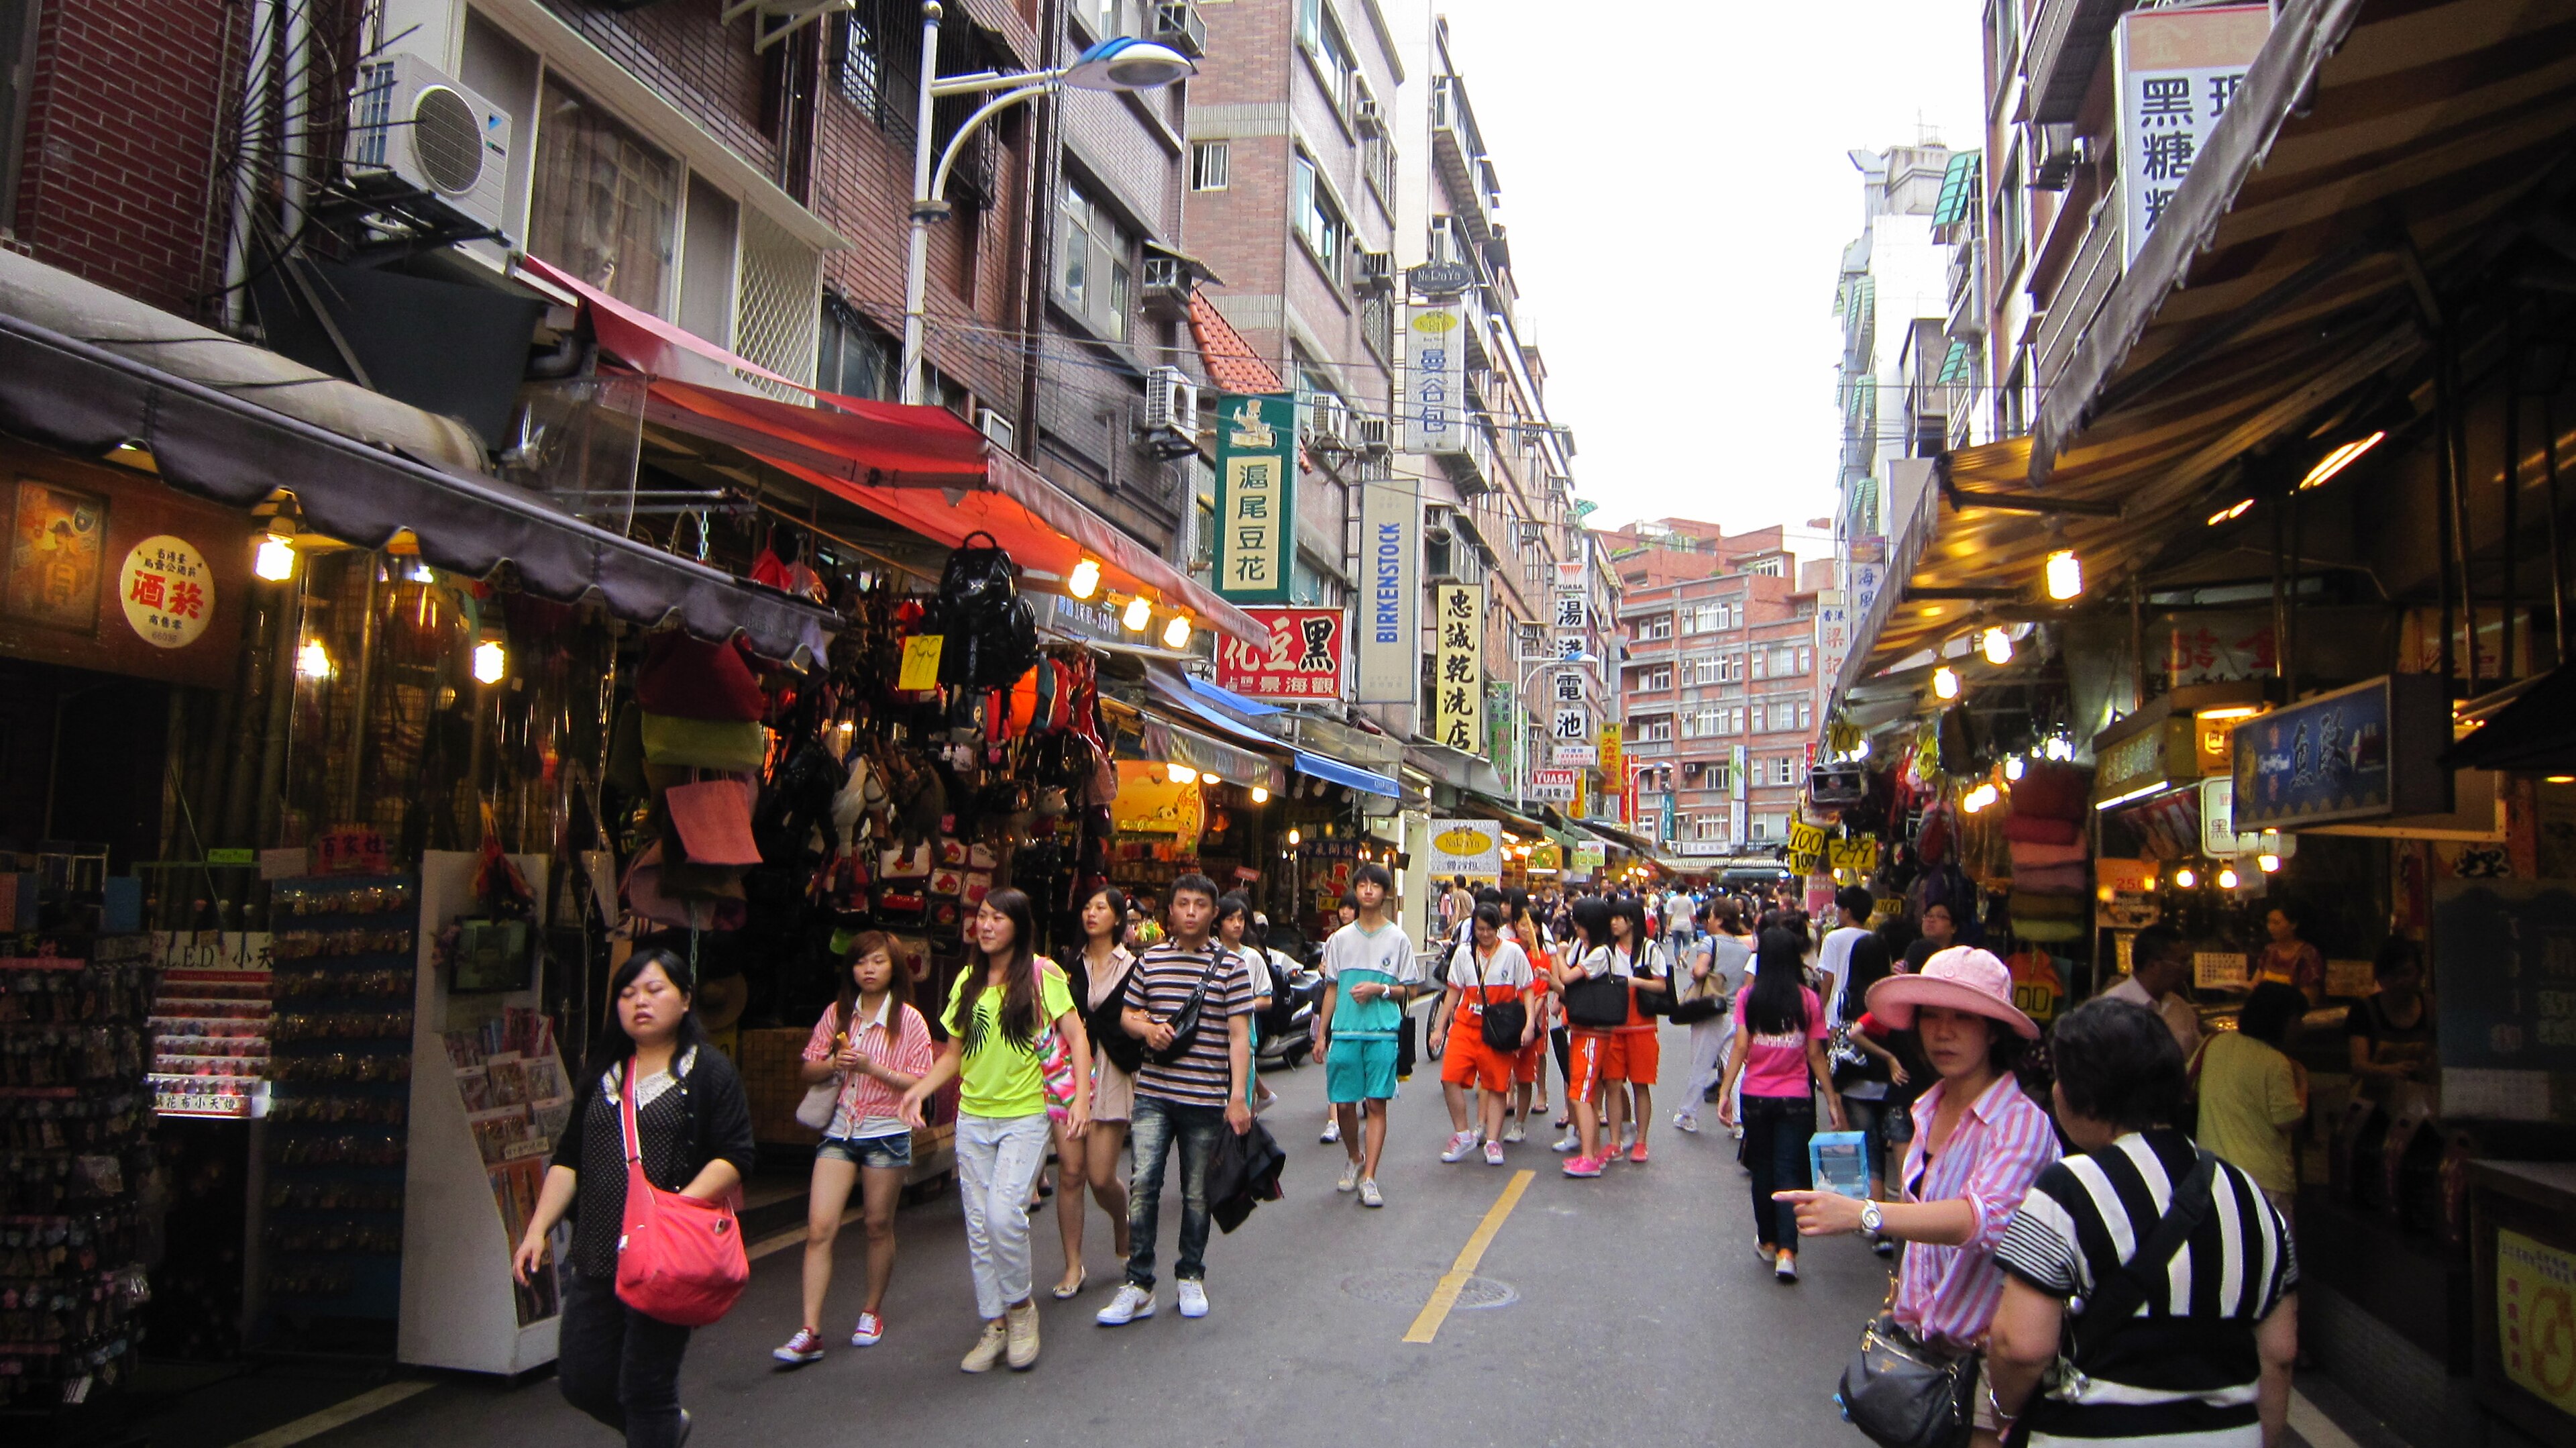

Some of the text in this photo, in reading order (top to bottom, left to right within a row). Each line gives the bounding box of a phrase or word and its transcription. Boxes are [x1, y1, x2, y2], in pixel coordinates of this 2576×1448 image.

[1419, 349, 1448, 433] 曼谷包
[1236, 464, 1268, 581] 滬尾豆花
[1376, 522, 1400, 643] BIRKENSTOCK
[1444, 589, 1475, 749] 忠誠乾洗店
[1535, 771, 1571, 784] YUASA
[1790, 827, 1823, 852] 100
[1833, 843, 1872, 864] 299
[2015, 986, 2049, 1012] 00
